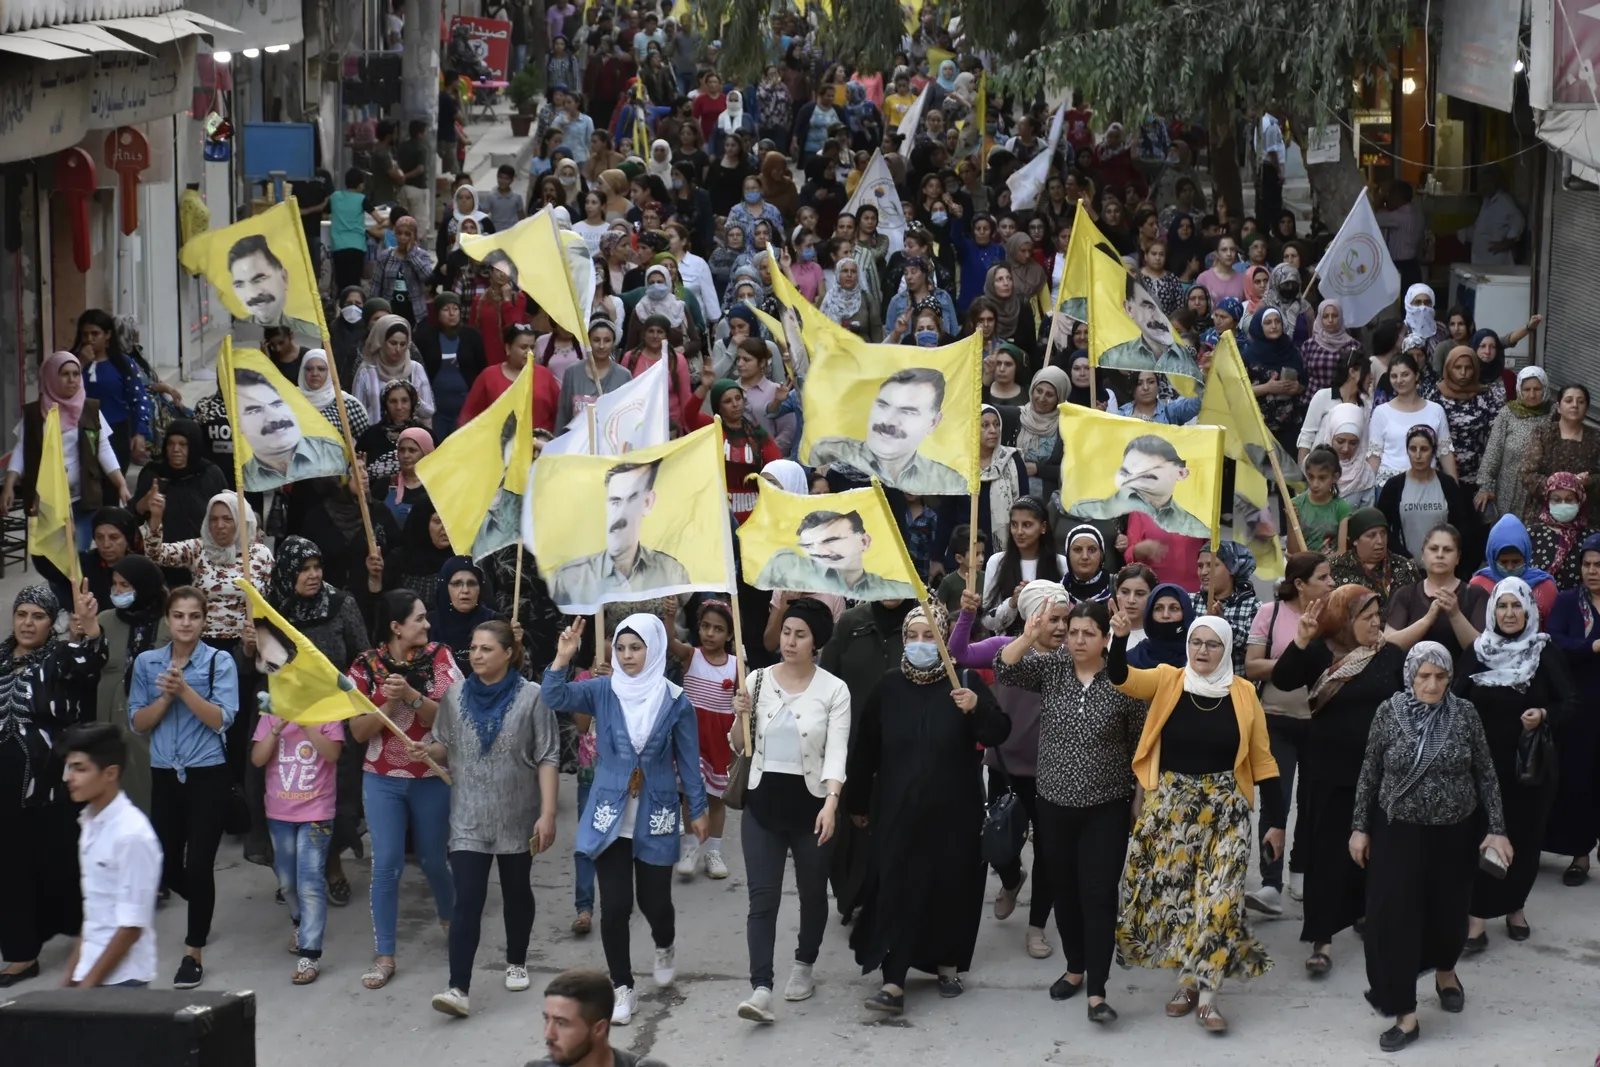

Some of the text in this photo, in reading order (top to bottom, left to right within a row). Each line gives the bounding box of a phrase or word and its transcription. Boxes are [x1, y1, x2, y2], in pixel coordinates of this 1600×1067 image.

[452, 18, 507, 40] صيدلة
[279, 738, 318, 765] LO
[279, 763, 318, 792] VE
